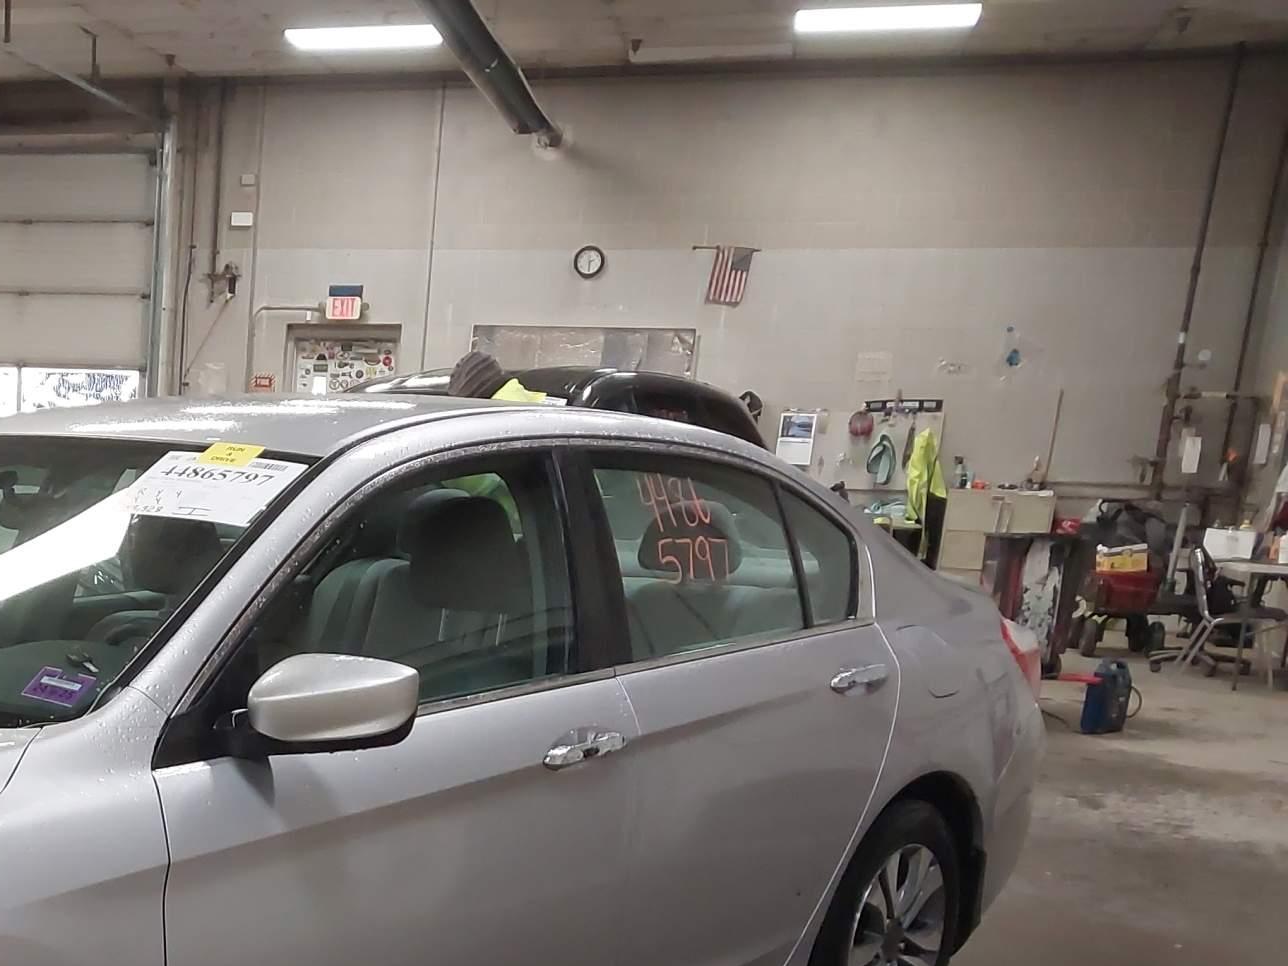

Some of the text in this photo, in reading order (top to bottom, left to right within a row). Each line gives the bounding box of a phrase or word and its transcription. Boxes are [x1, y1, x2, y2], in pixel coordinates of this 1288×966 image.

[332, 297, 356, 318] EXIT
[160, 464, 275, 487] 44865797
[657, 535, 729, 585] 5797
